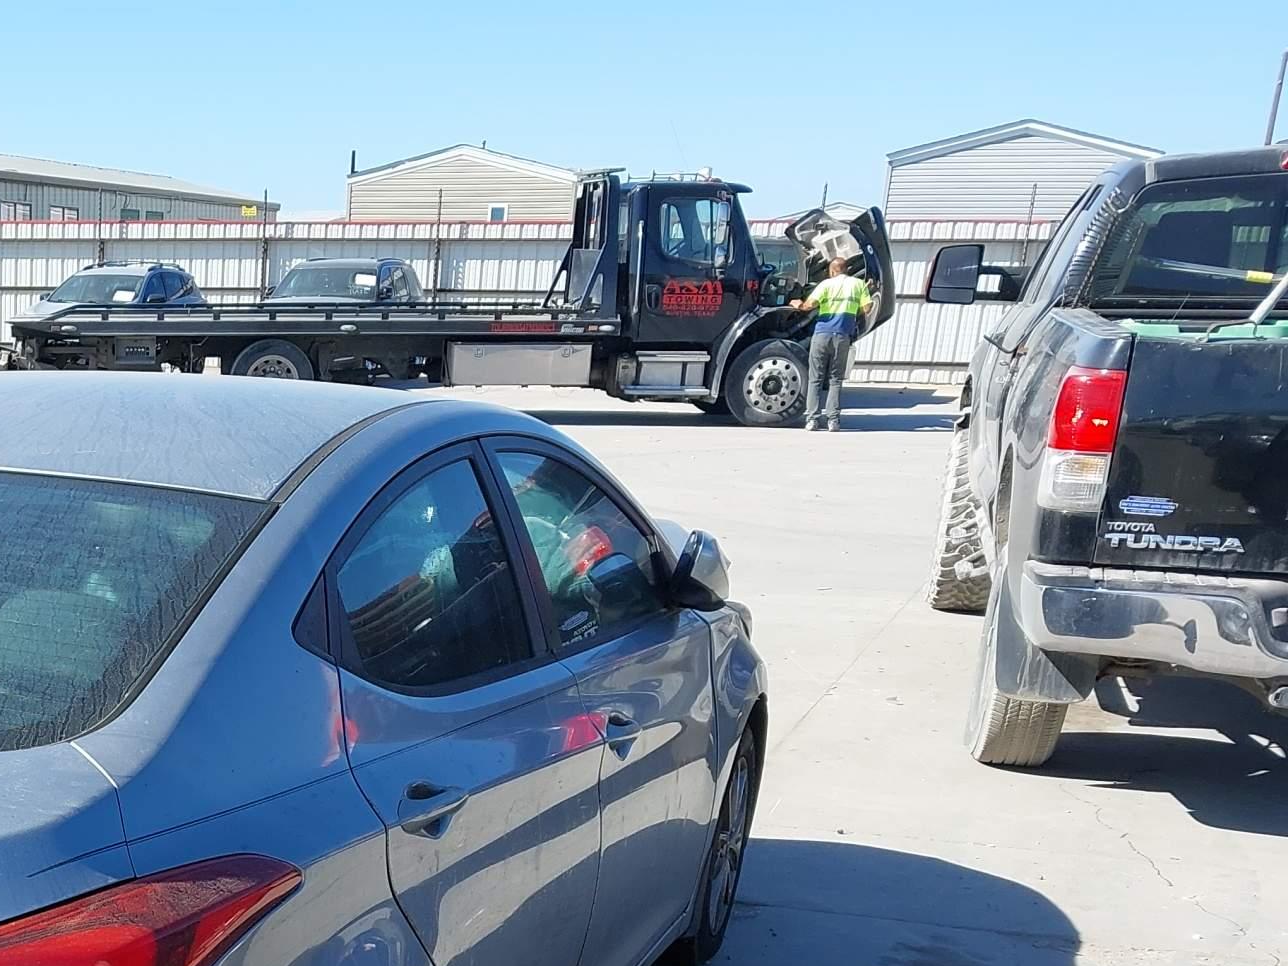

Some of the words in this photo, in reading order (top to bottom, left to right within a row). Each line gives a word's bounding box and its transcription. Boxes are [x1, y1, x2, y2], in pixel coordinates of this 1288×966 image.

[664, 295, 722, 304] TOWING
[1107, 521, 1155, 532] TOYOTA
[1104, 533, 1246, 553] TUNDRA
